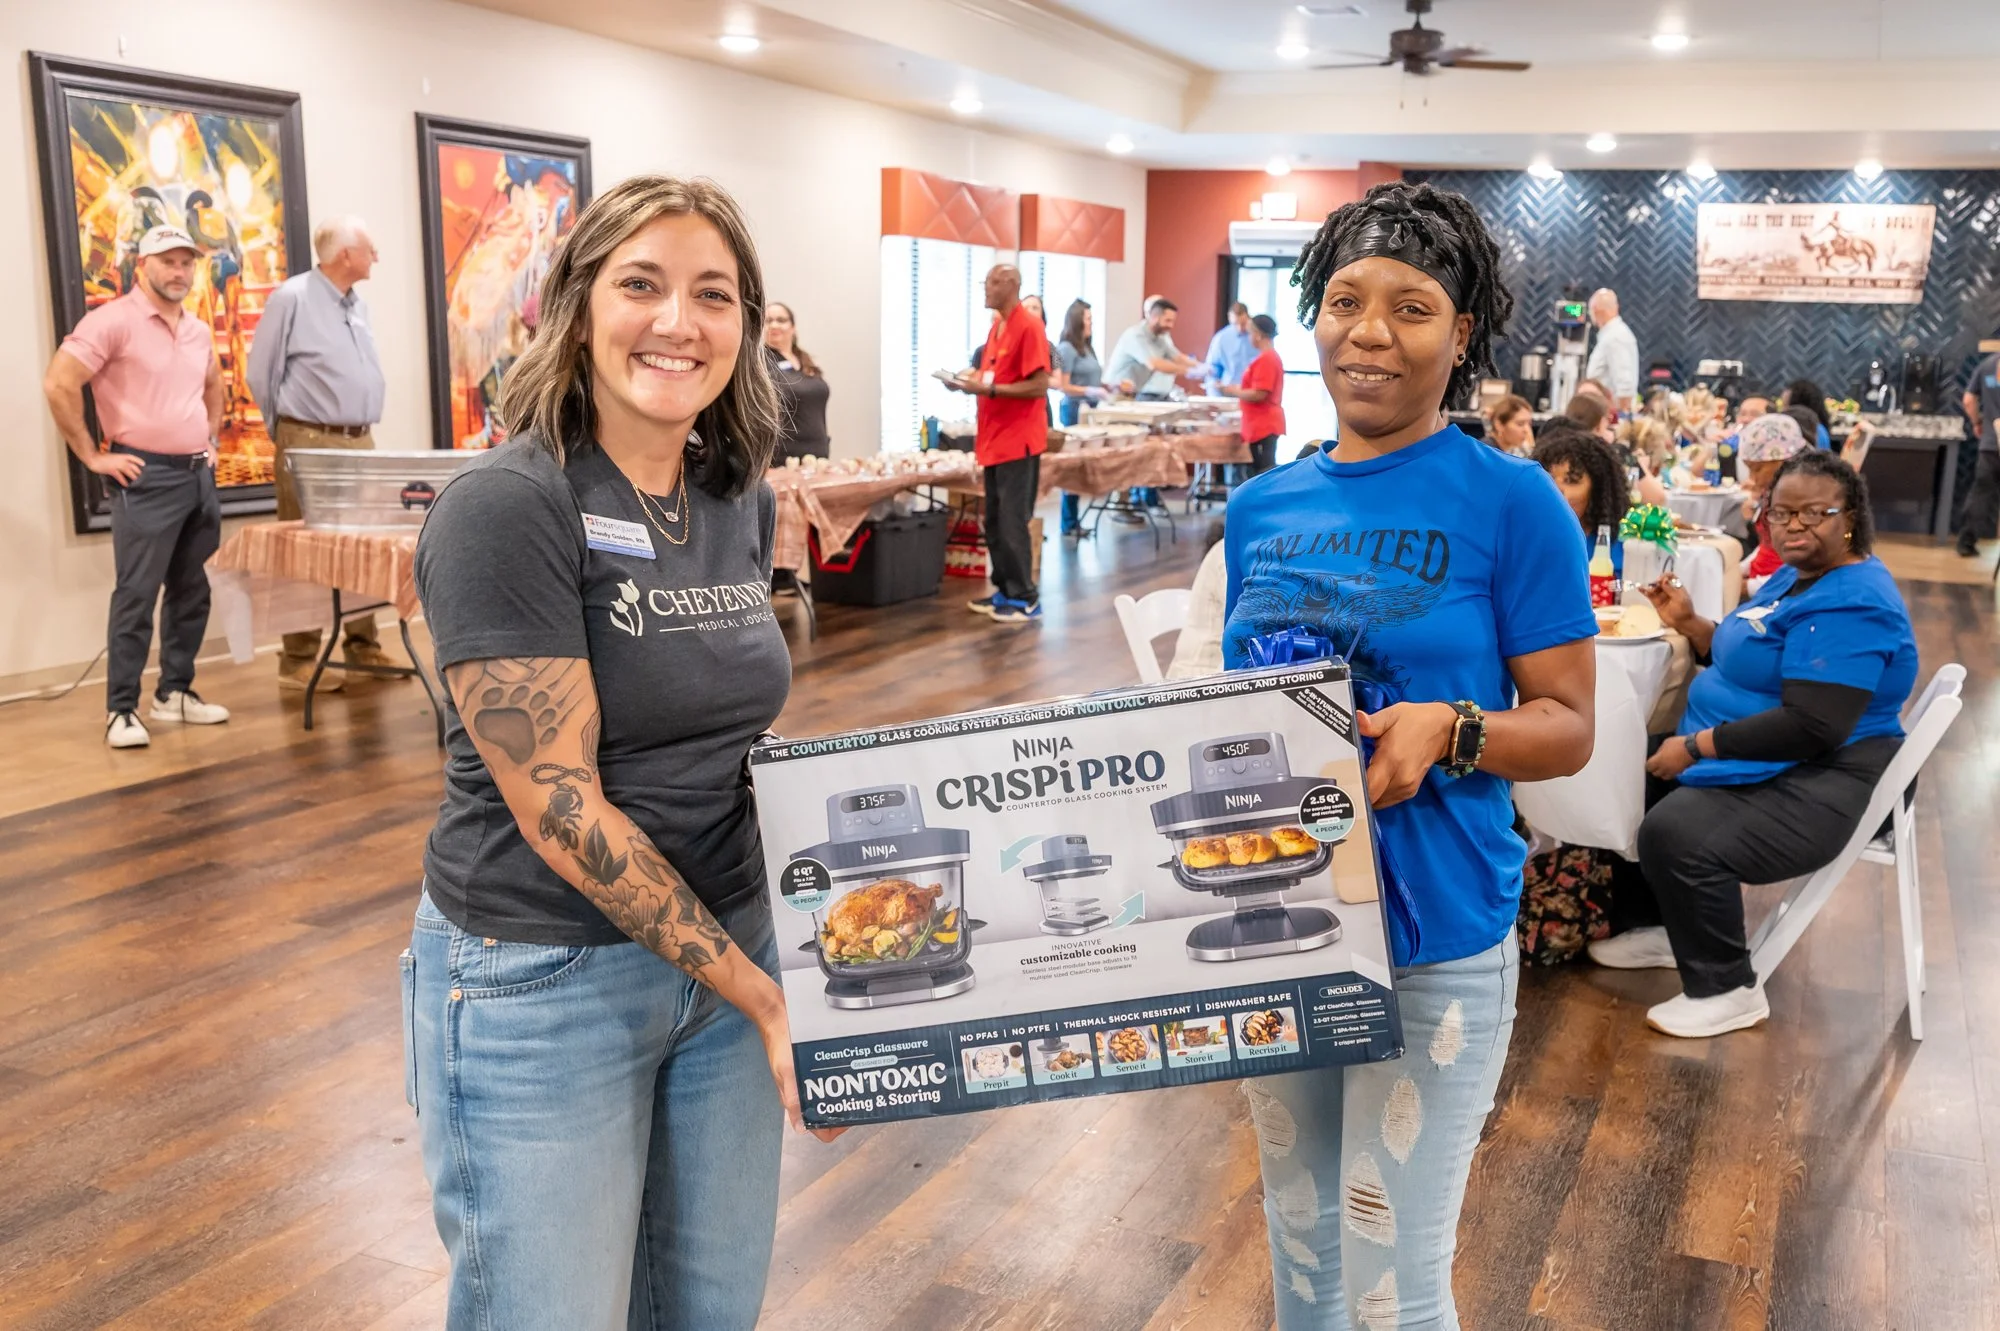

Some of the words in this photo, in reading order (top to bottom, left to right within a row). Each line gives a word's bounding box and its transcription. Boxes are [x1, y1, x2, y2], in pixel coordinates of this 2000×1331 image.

[648, 581, 771, 616] CHEYENN
[697, 618, 740, 632] MEDICAL
[742, 611, 770, 626] LODGE
[769, 748, 789, 759] THE
[790, 734, 878, 757] COUNTERTOP
[879, 731, 912, 743] GLASS
[913, 723, 960, 738] COOKING
[961, 718, 1000, 731] SYSTEM
[1001, 710, 1052, 725] DESIGNED
[1054, 707, 1075, 718] FOR
[1076, 696, 1146, 715] NONTOXIC
[1147, 690, 1201, 704] PREPPING,
[1202, 682, 1253, 696] COOKING,
[1254, 677, 1278, 689] AND
[1279, 671, 1324, 685] STORING
[1320, 699, 1351, 725] FUNCTIONS
[1012, 736, 1074, 762] NINJA
[1222, 742, 1250, 756] 450F
[936, 759, 1075, 813] CRISPi
[1077, 750, 1166, 791] PRO
[860, 794, 886, 809] 375F
[1006, 798, 1062, 812] COUNTERTOP
[1064, 794, 1092, 804] GLASS
[1094, 787, 1133, 799] COOKING
[1135, 783, 1168, 794] SYSTEM
[1224, 793, 1263, 810] NINJA
[1310, 795, 1326, 805] 2.5
[1326, 793, 1340, 804] QT
[1321, 824, 1344, 833] PEOPLE
[861, 844, 898, 860] NINJA
[793, 868, 800, 876] 6
[800, 866, 814, 876] QT
[800, 896, 823, 904] PEOPLE
[1051, 938, 1102, 951] INNOVATIVE
[1020, 947, 1092, 966] customizable
[1093, 943, 1137, 956] cooking
[1029, 972, 1052, 981] multiple
[1103, 963, 1133, 972] Glassware
[1048, 964, 1062, 972] steel
[1062, 961, 1086, 970] modular
[1327, 985, 1364, 996] INCLUDES
[960, 1034, 974, 1042] NO
[975, 1031, 999, 1041] PFAS
[1011, 1027, 1026, 1036] NO
[1027, 1024, 1051, 1034] PTFE
[1063, 1017, 1107, 1030] THERMAL
[1108, 1012, 1140, 1024] SHOCK
[1142, 1005, 1191, 1019] RESISTANT
[1205, 996, 1266, 1011] DISHWASHER
[1267, 993, 1292, 1003] SAFE
[1337, 1026, 1360, 1034] BPA-free
[873, 1039, 928, 1054] Glassware
[1249, 1046, 1278, 1057] Recrisp
[1278, 1044, 1287, 1052] it
[853, 1059, 882, 1068] DESIGNED
[1185, 1055, 1207, 1064] Store
[1207, 1054, 1214, 1062] it
[1050, 1071, 1071, 1081] Cook
[1116, 1064, 1139, 1073] Serve
[803, 1062, 947, 1100] NONTOXIC
[983, 1080, 1002, 1090] Prep
[1002, 1079, 1009, 1087] it
[816, 1098, 873, 1114] Cooking
[875, 1095, 887, 1107] &
[888, 1089, 941, 1106] Storing
